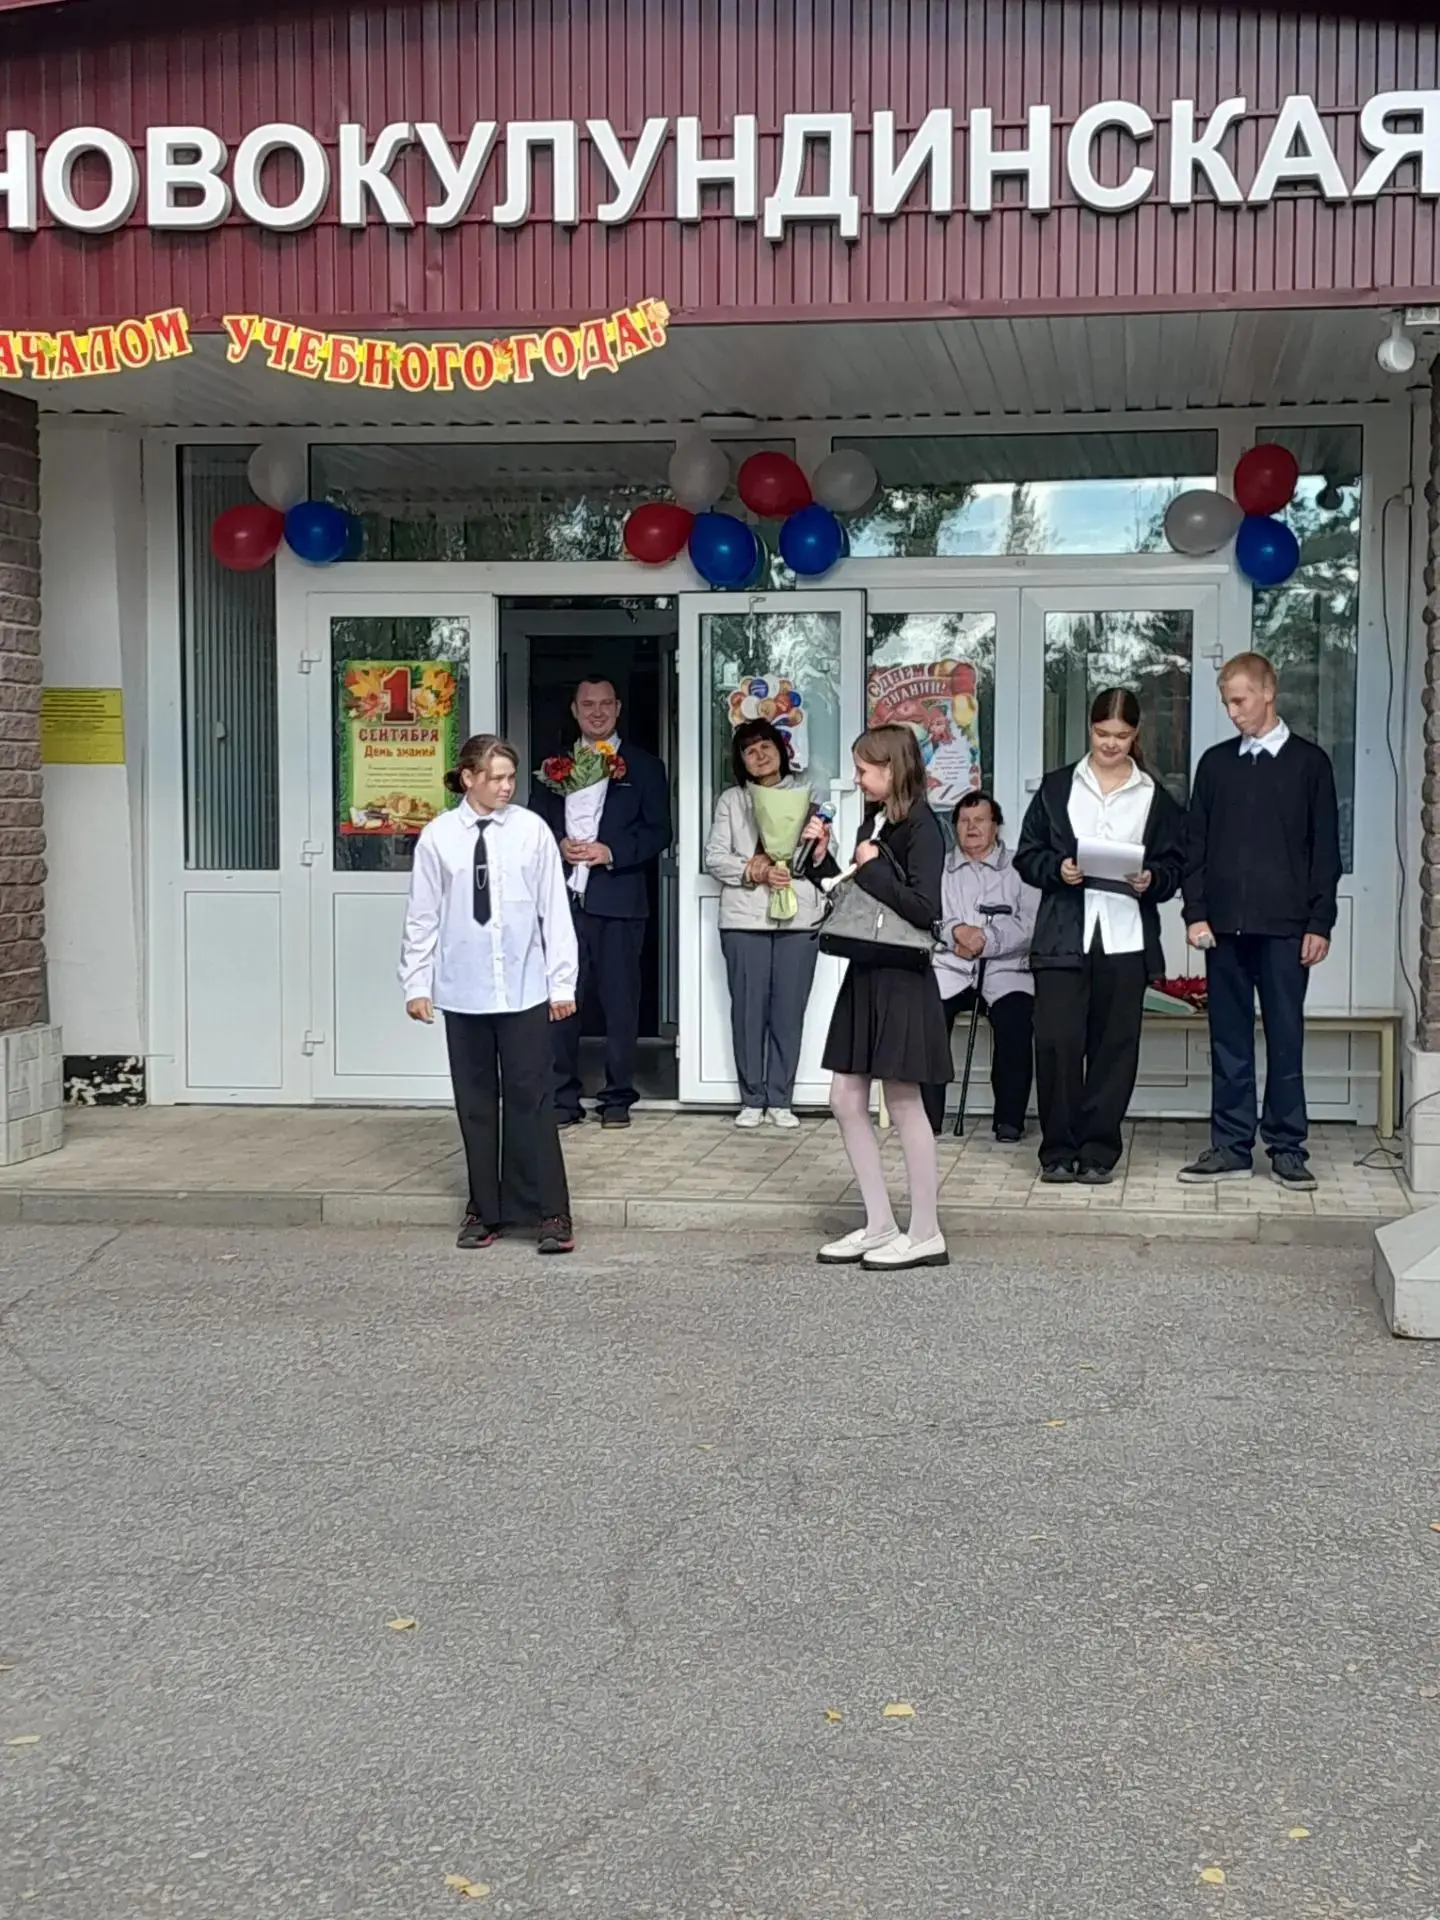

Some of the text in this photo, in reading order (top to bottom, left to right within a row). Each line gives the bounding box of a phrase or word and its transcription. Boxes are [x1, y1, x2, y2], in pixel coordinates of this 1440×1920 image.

[223, 315, 494, 391] УЧЕБНОГО
[510, 298, 667, 382] ГОДА!
[383, 667, 416, 724] 1
[868, 682, 882, 699] С
[358, 728, 439, 742] СЕНТЯБРЯ
